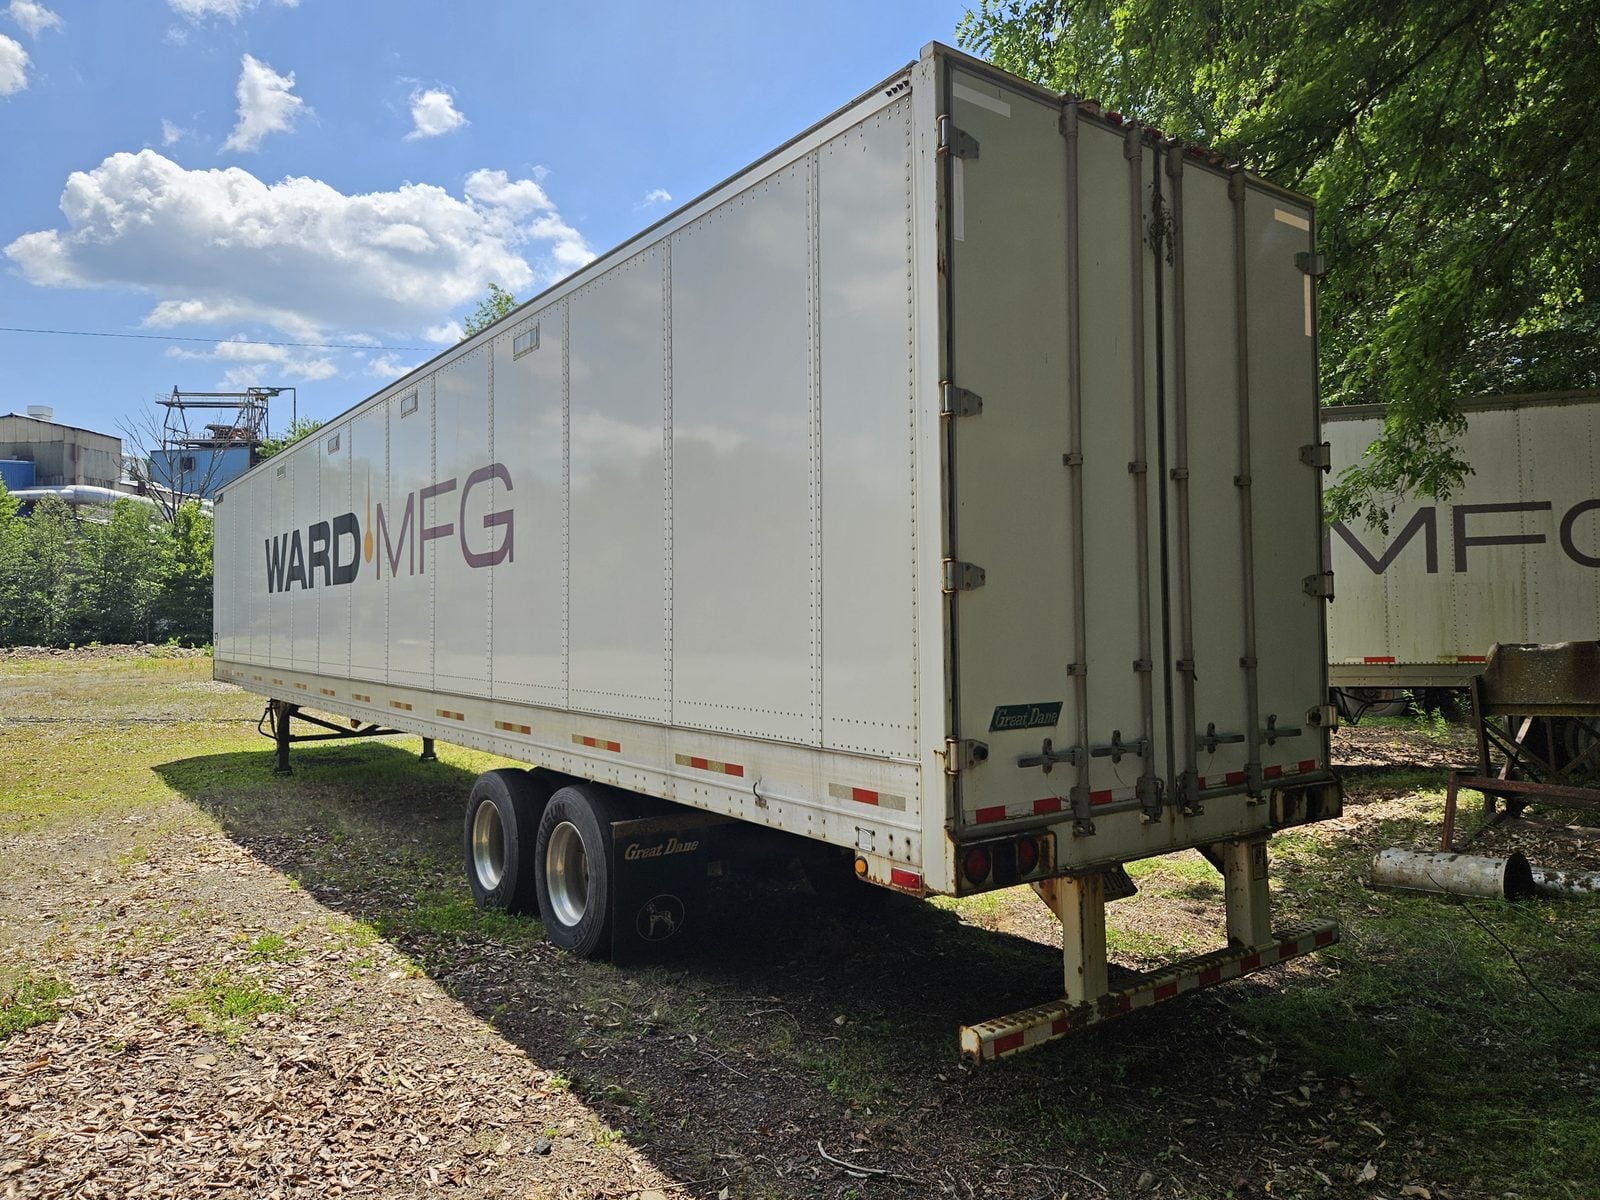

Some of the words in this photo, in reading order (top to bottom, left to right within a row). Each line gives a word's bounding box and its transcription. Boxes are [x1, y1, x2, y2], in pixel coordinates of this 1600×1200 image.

[265, 512, 361, 593] WARD
[376, 462, 514, 580] MFG
[995, 708, 1028, 727] Great
[1028, 707, 1058, 725] Dane
[624, 842, 664, 861] Great
[663, 837, 700, 855] Dane
